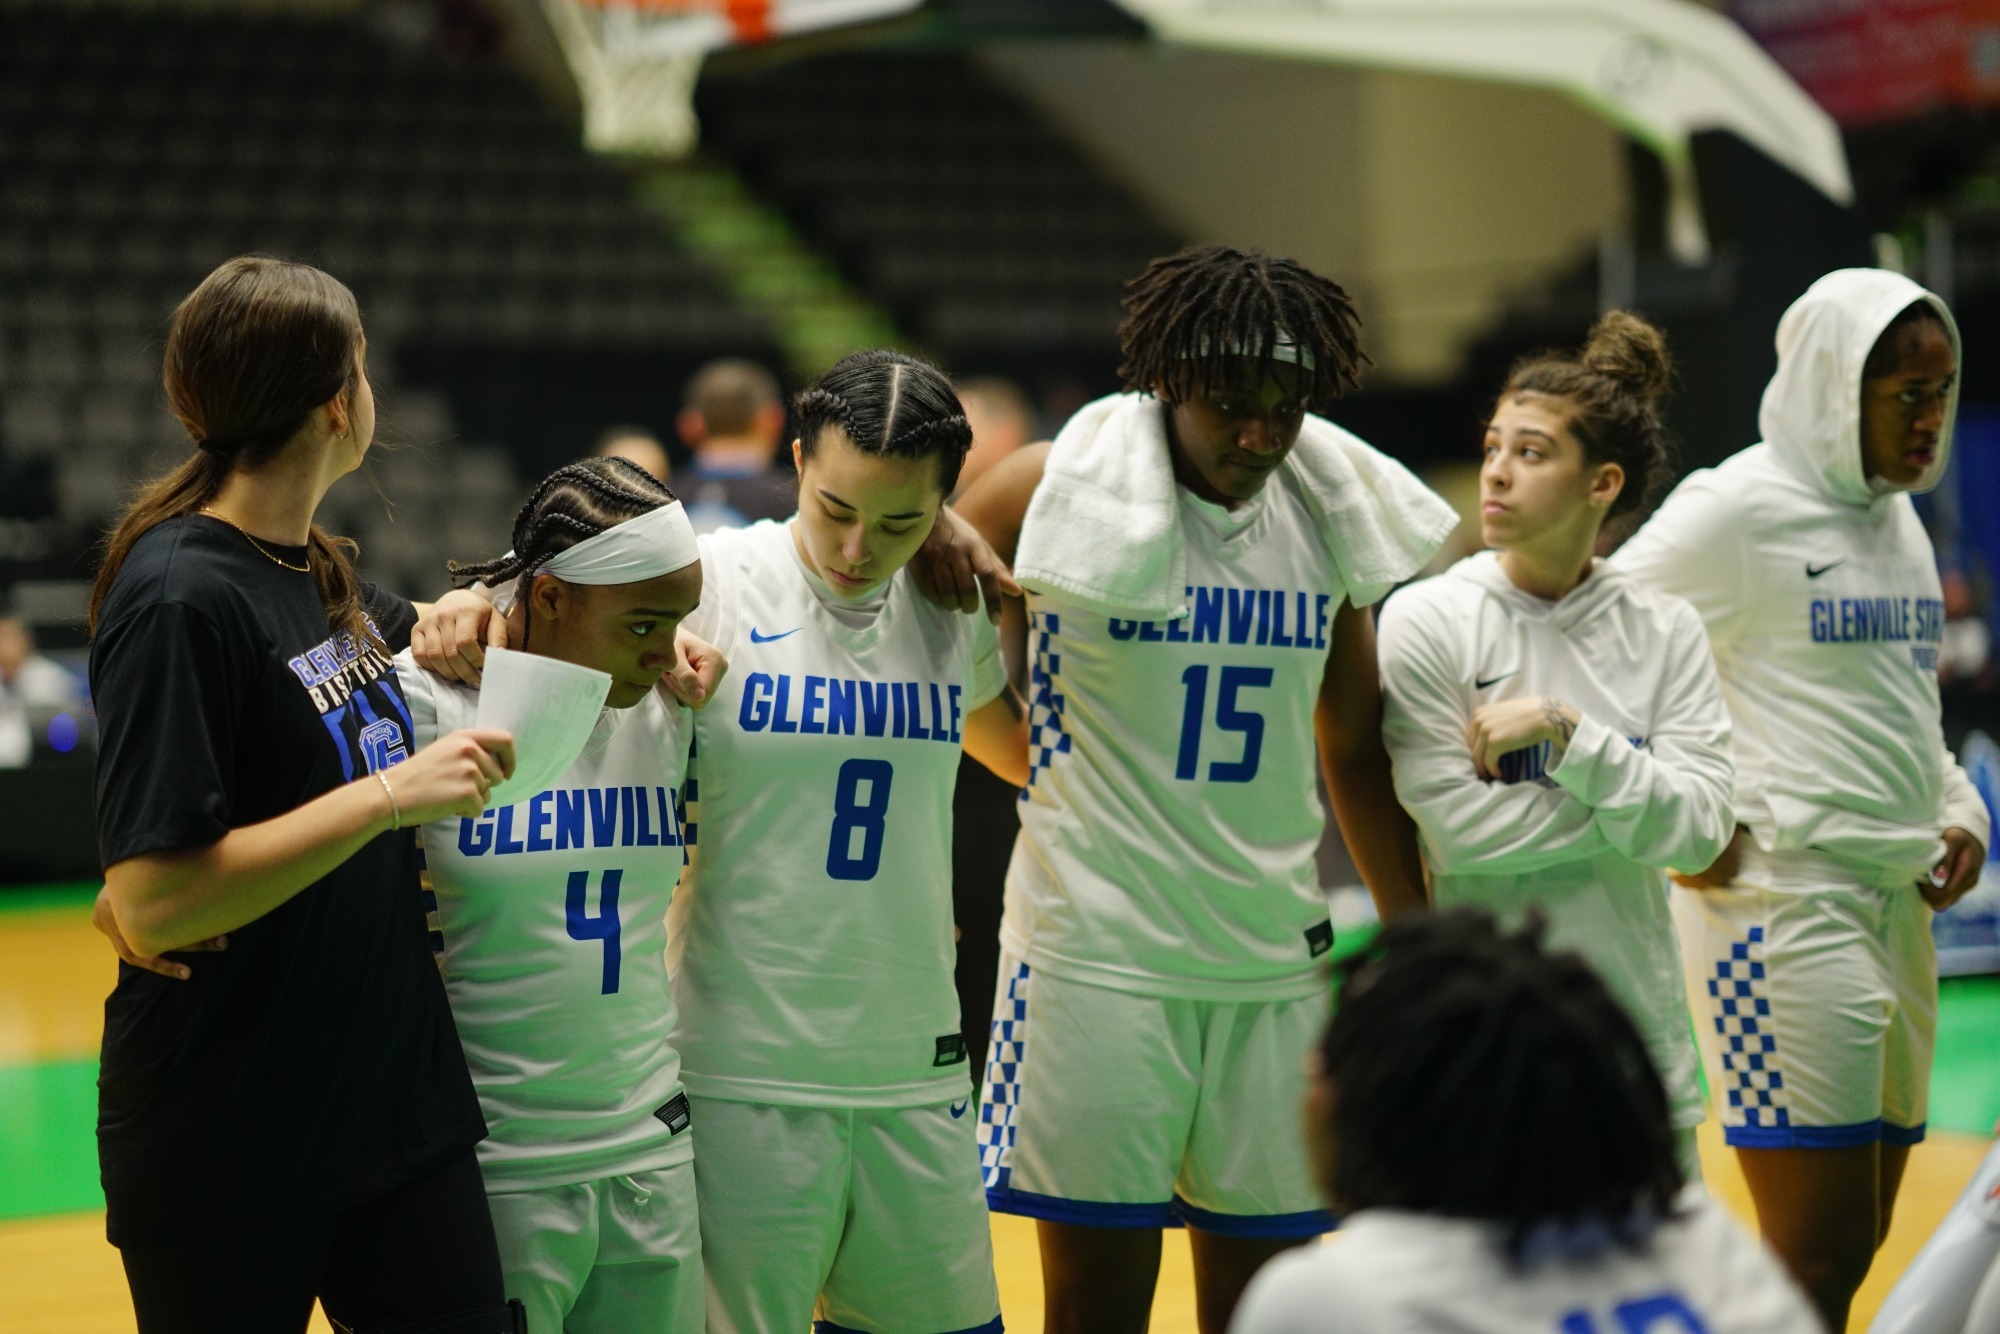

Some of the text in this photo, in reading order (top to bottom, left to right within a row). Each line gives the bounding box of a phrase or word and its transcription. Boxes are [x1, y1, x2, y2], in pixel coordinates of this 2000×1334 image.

[1811, 597, 1910, 643] GLENVILLE
[739, 672, 962, 744] GLENVILLE
[1175, 664, 1274, 783] 15
[826, 758, 894, 881] 8
[565, 869, 624, 995] 4
